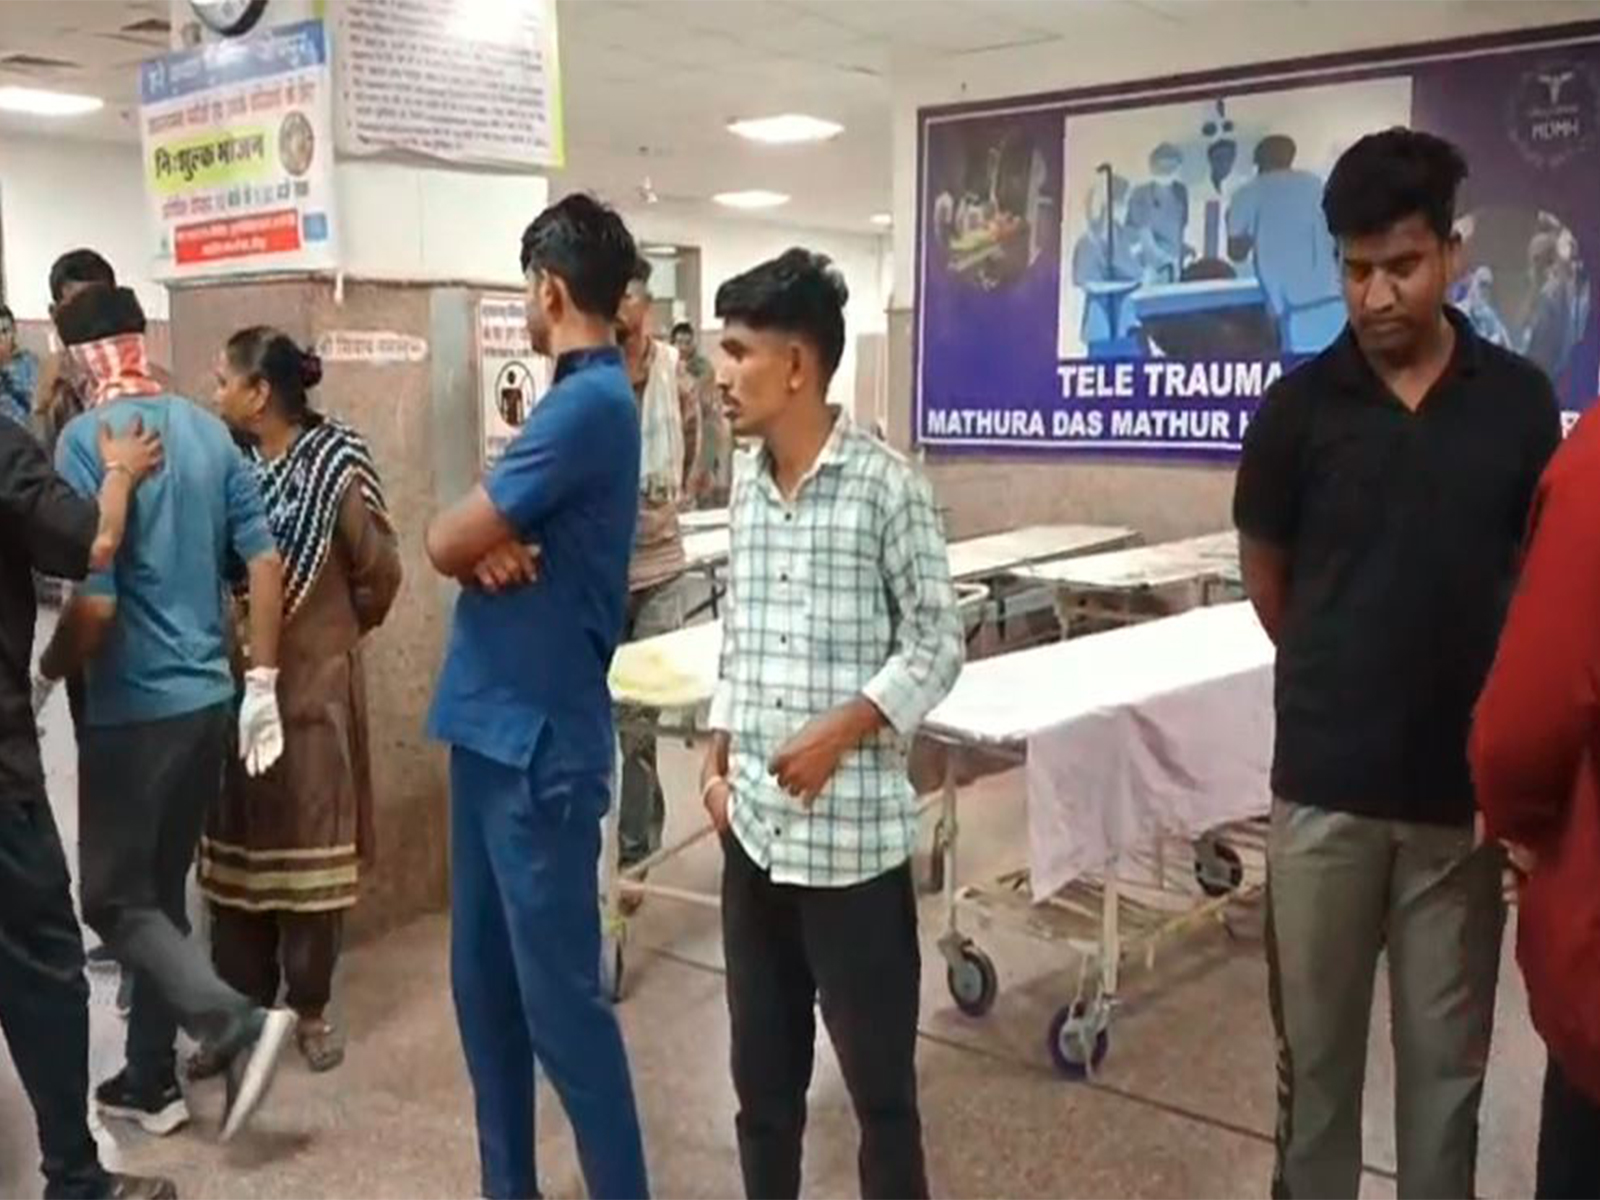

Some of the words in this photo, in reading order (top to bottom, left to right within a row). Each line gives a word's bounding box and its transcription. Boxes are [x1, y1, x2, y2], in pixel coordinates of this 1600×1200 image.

[1057, 364, 1134, 398] TELE
[927, 409, 1045, 436] MATHURA
[1052, 410, 1102, 437] DAS
[1110, 410, 1230, 439] MATHUR
